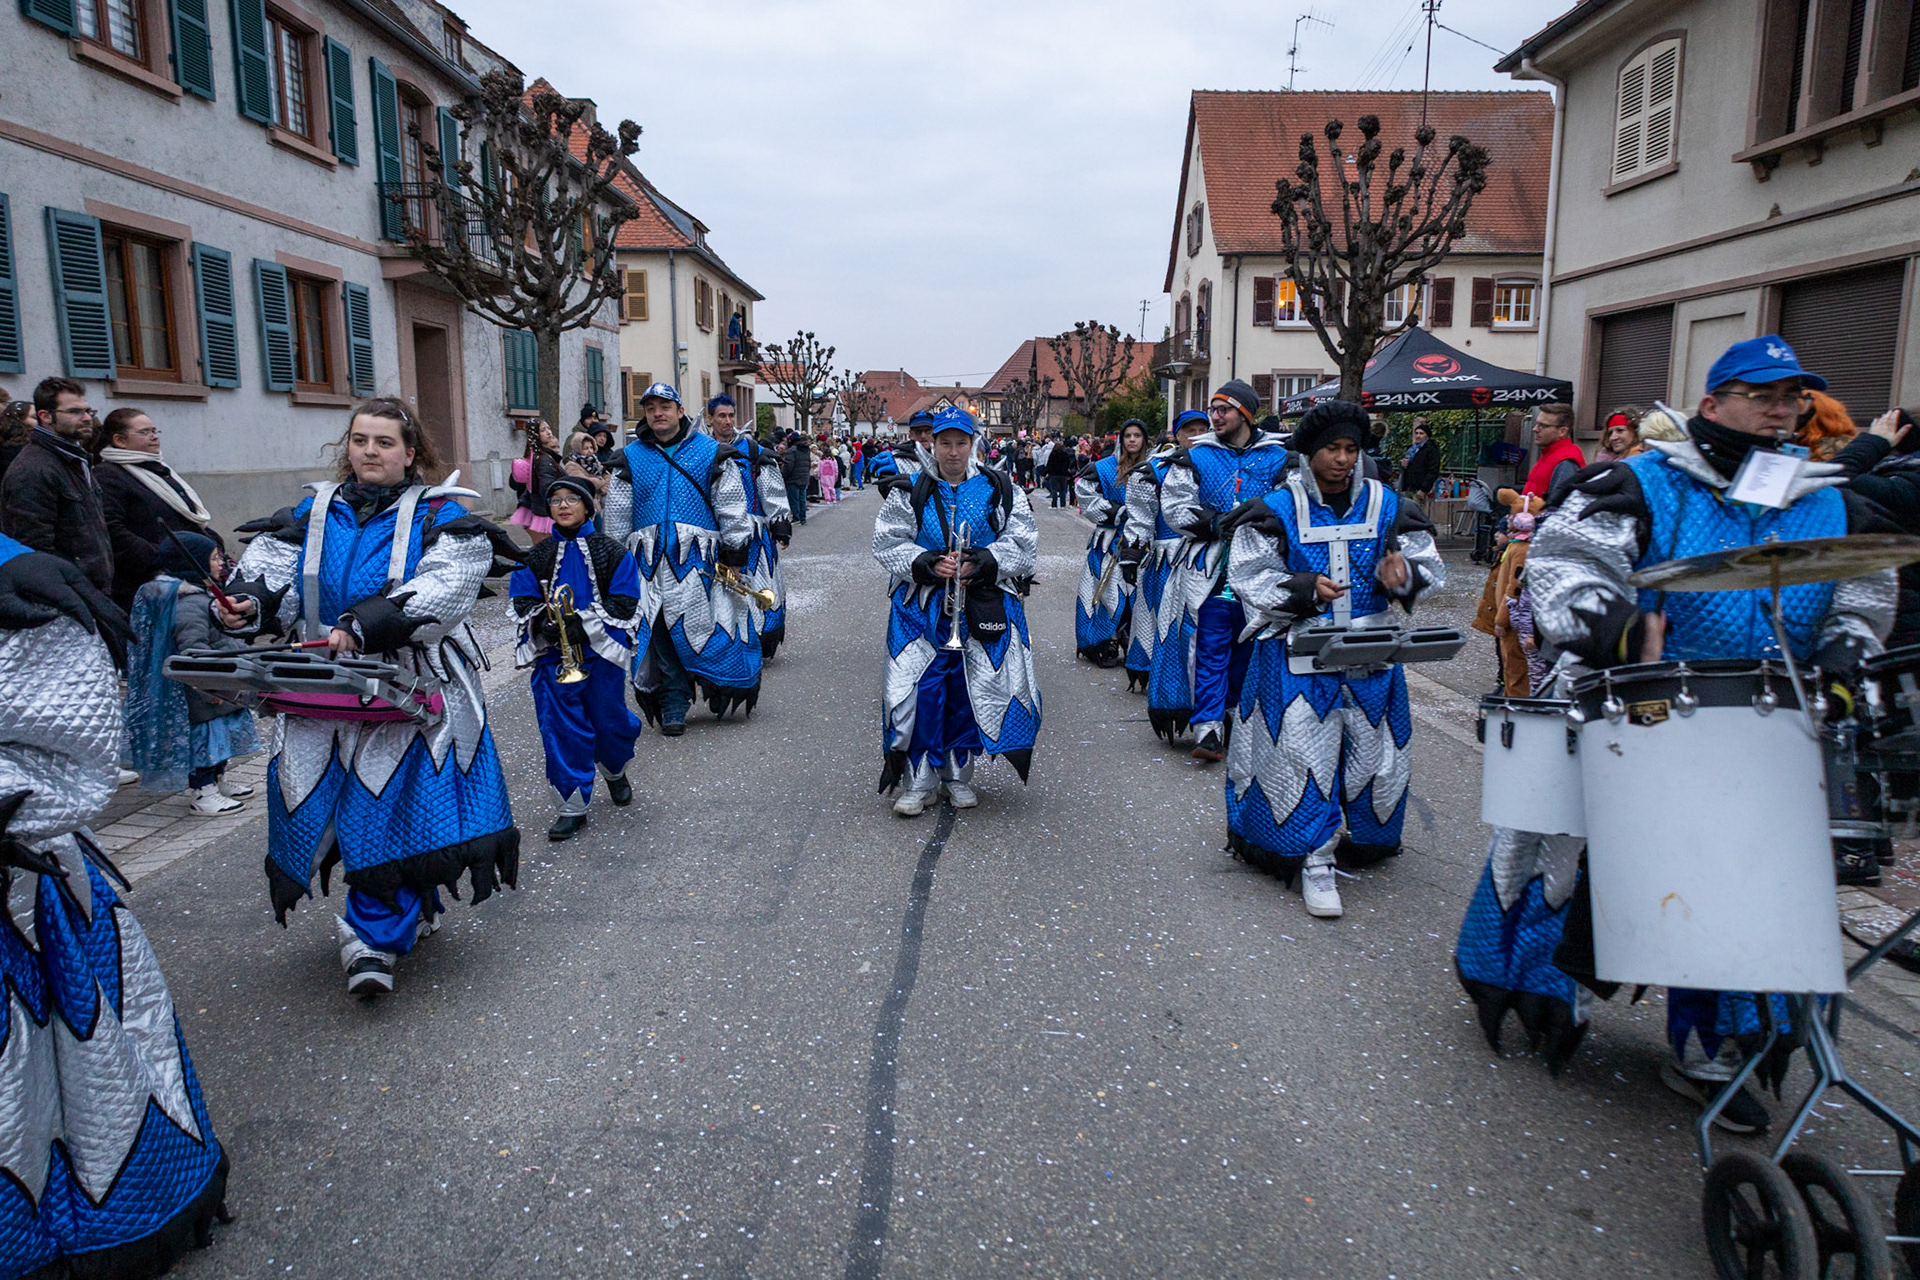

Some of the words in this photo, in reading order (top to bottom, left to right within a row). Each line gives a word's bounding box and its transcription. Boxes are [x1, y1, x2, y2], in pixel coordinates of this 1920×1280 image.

[1411, 374, 1483, 385] 24MX
[1374, 391, 1441, 406] 24MX
[1492, 388, 1559, 402] 24MX
[979, 622, 1007, 631] adidas
